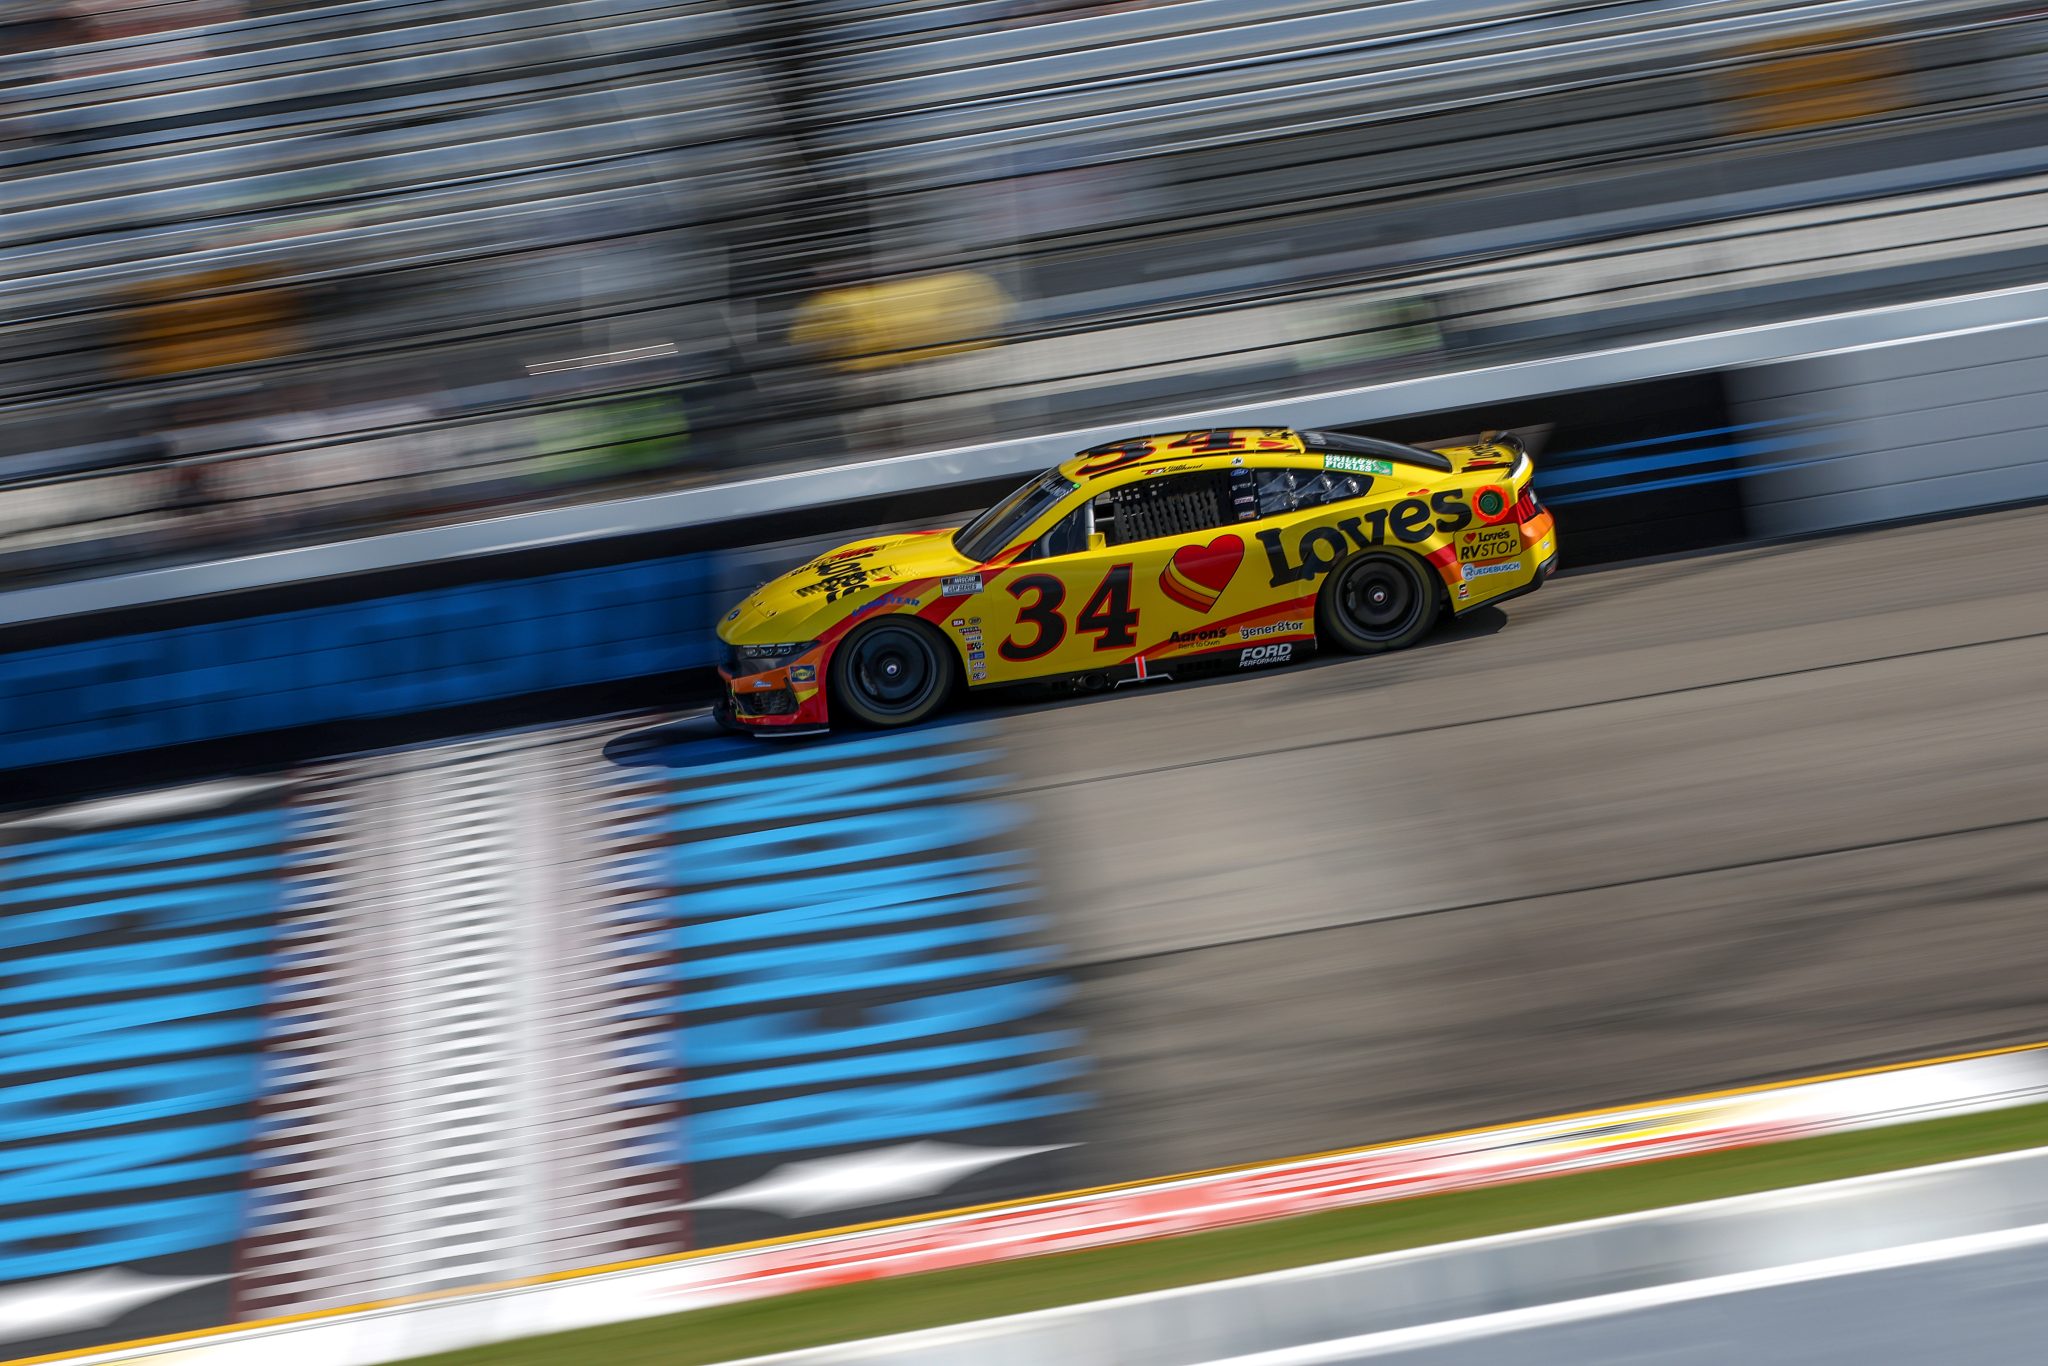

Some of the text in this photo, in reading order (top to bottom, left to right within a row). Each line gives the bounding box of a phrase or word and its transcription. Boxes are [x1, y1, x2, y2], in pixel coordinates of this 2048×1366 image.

[1075, 431, 1247, 476] 34
[1325, 460, 1372, 473] PICKLES
[1481, 540, 1517, 557] STOP
[954, 575, 976, 583] NASCAR
[998, 563, 1140, 662] 34
[1169, 627, 1228, 643] Aaron's
[1241, 621, 1304, 640] gener8tor
[1239, 655, 1292, 667] PERFORMANCE
[1240, 643, 1293, 662] FORD
